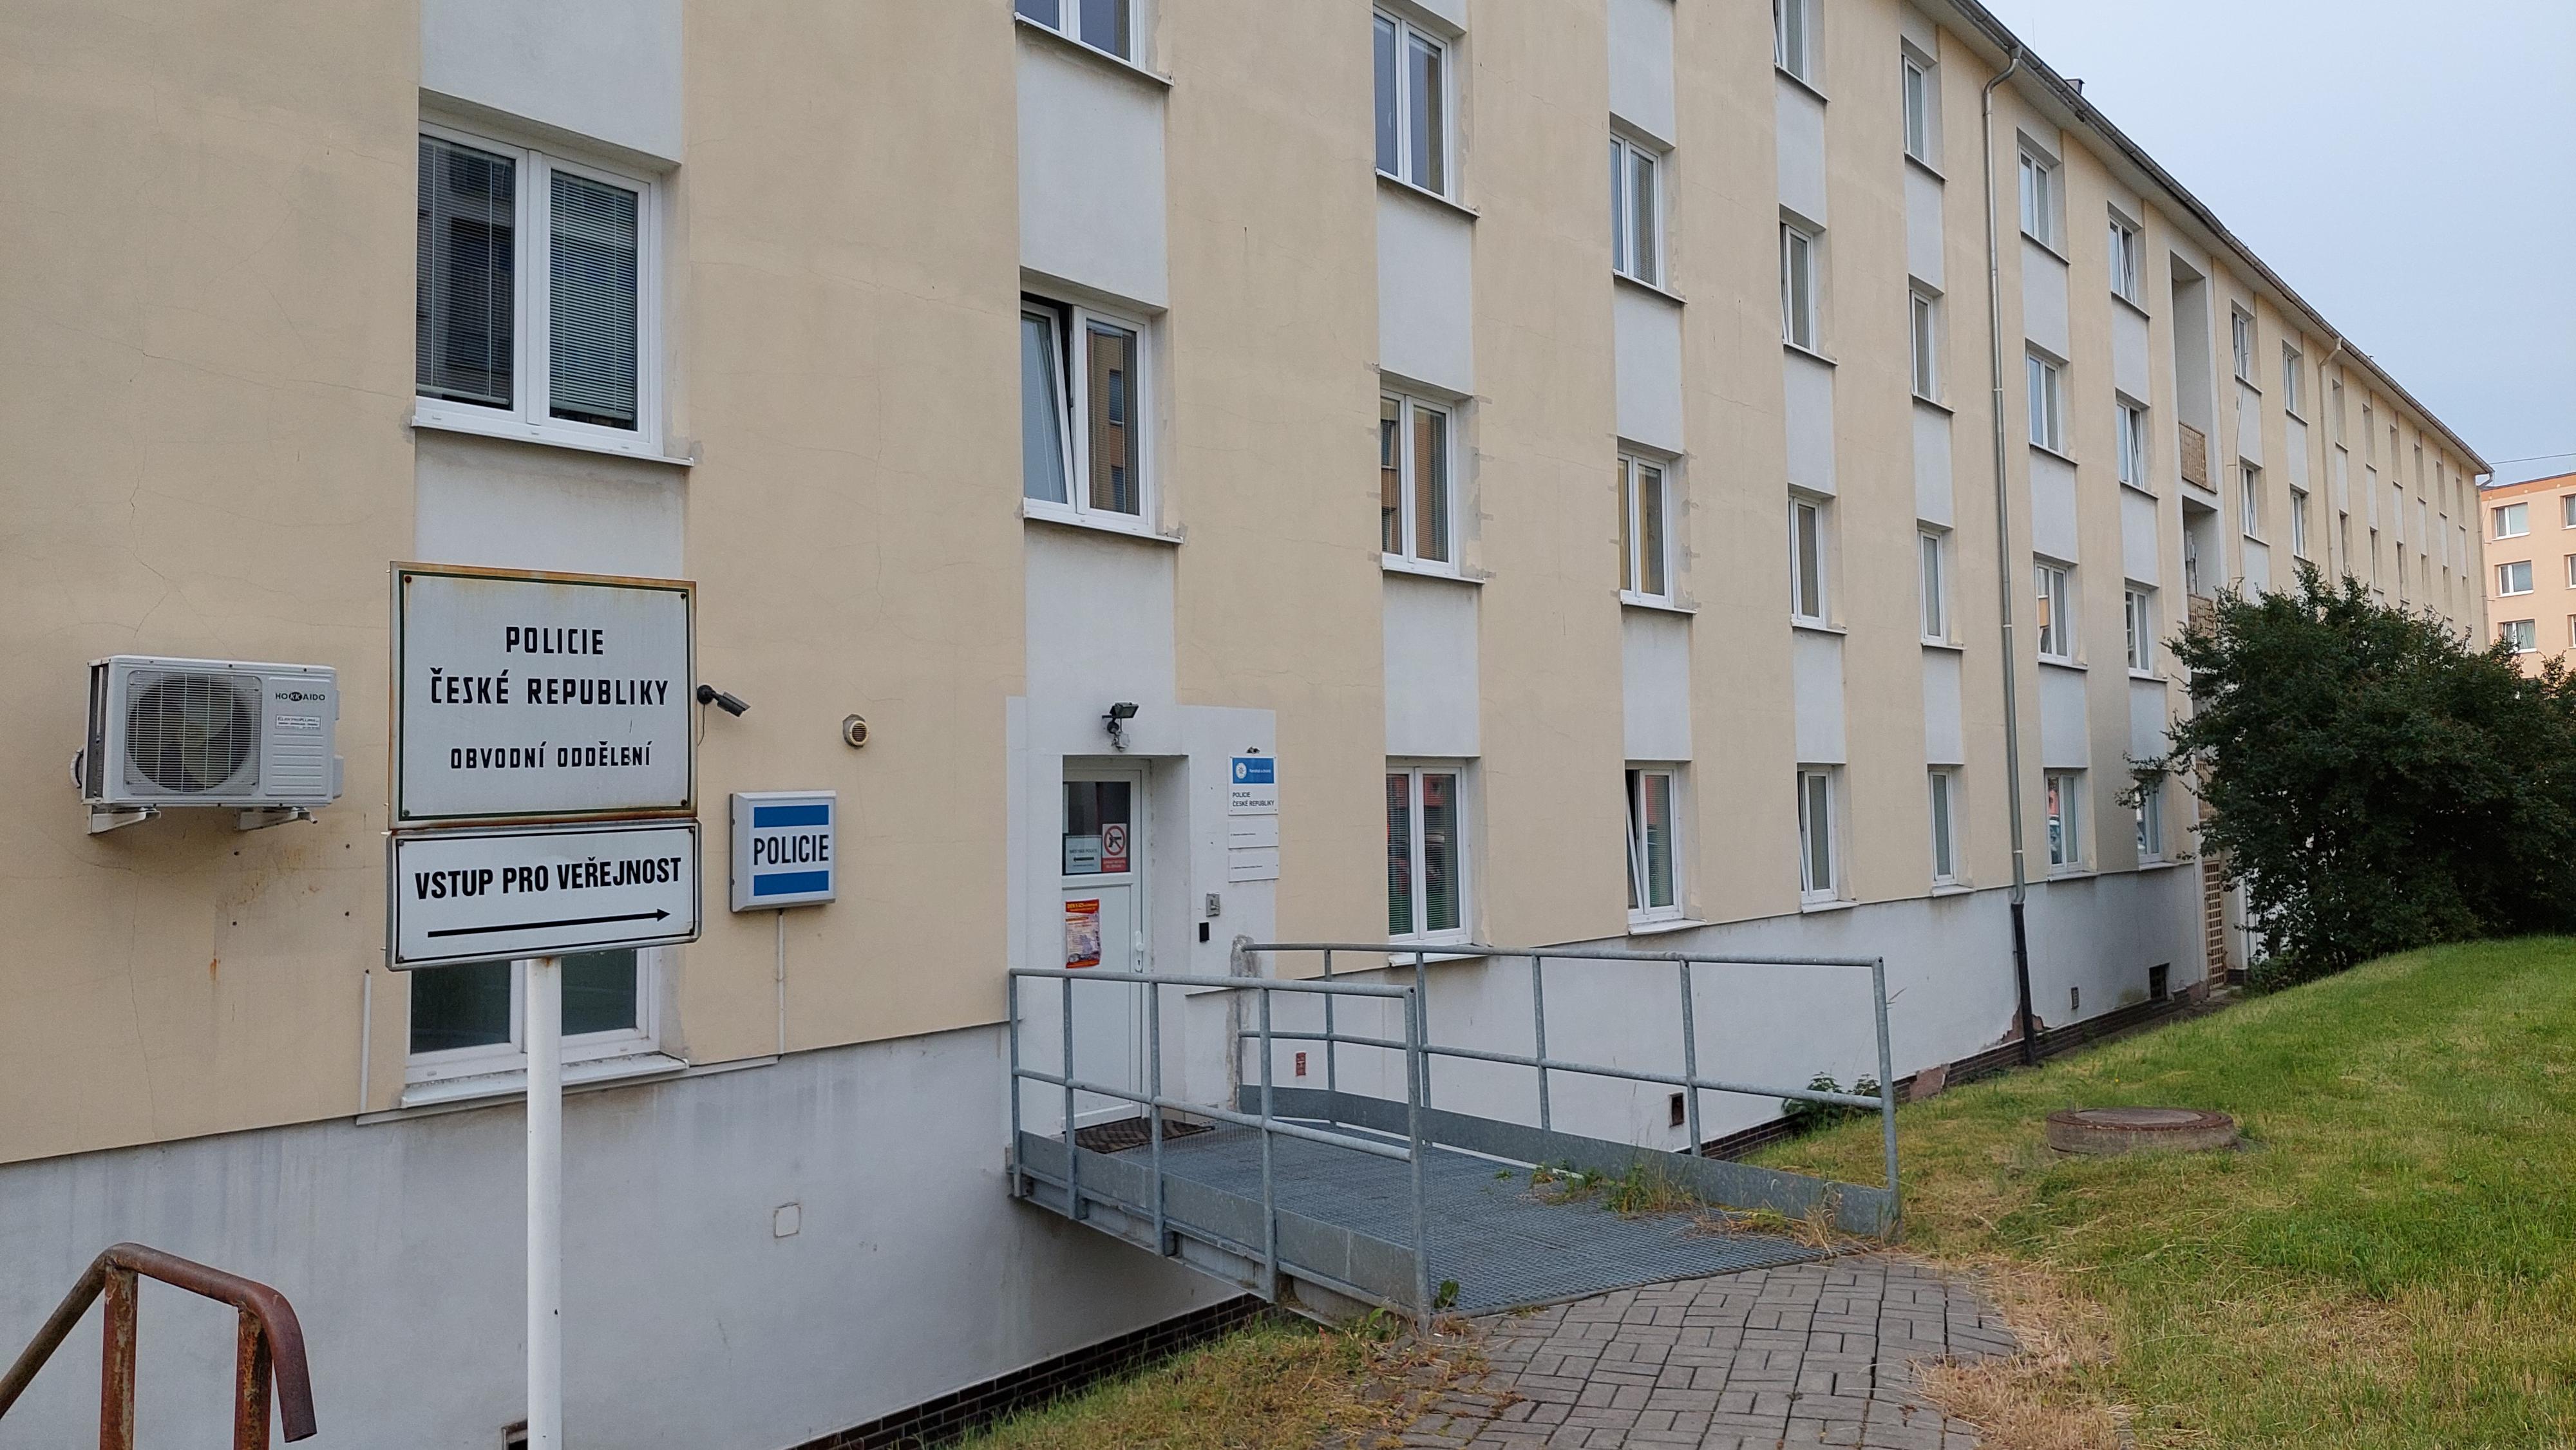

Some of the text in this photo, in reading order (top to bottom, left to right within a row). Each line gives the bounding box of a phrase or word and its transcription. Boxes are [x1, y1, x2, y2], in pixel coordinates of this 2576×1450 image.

[506, 626, 603, 655] POLICIE
[275, 692, 326, 701] HOKKAIDO
[430, 667, 668, 705] ČESKÉ REPUBLIKY
[451, 741, 652, 769] OBVODNÍ ODDĚLENÍ
[754, 834, 829, 865] POLICIE
[415, 857, 681, 900] VSTUP PRO VEŘEJNOST
